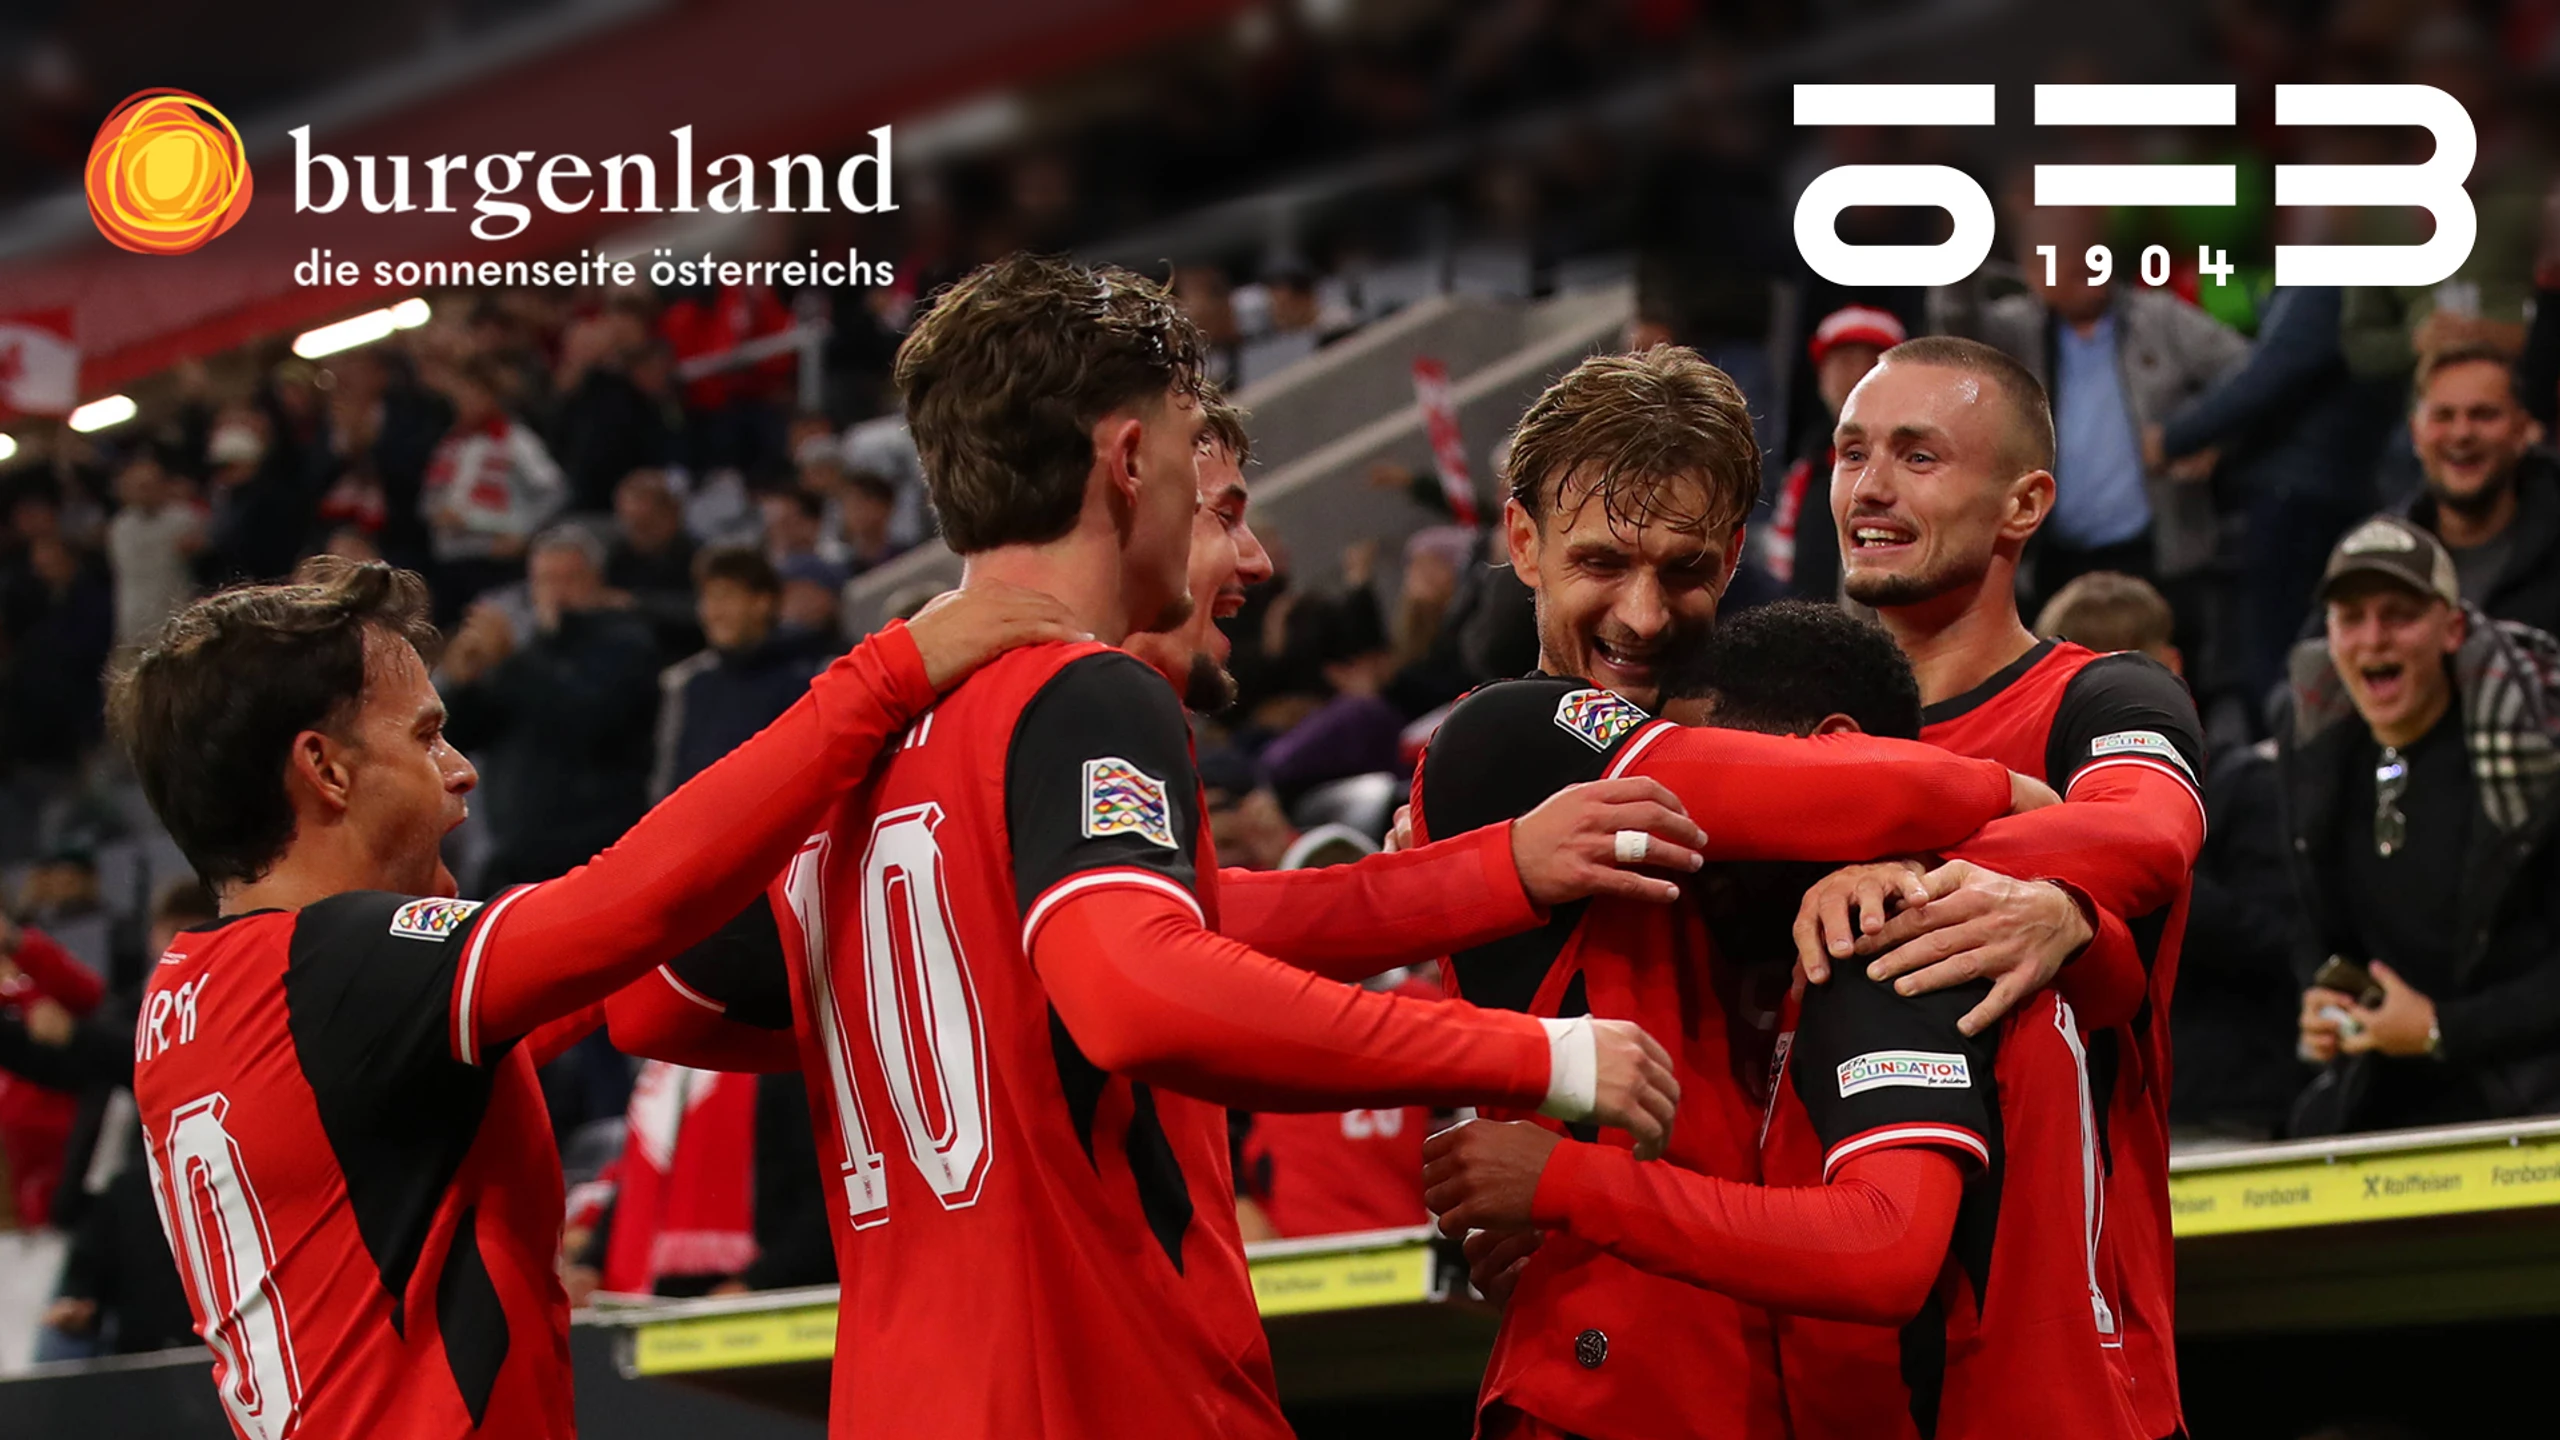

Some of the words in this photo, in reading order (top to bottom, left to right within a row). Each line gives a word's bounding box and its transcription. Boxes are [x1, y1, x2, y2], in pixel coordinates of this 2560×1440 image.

[784, 801, 994, 1231] 10
[1840, 1057, 1867, 1074] UEFA
[1841, 1061, 1966, 1085] FOUNDATION
